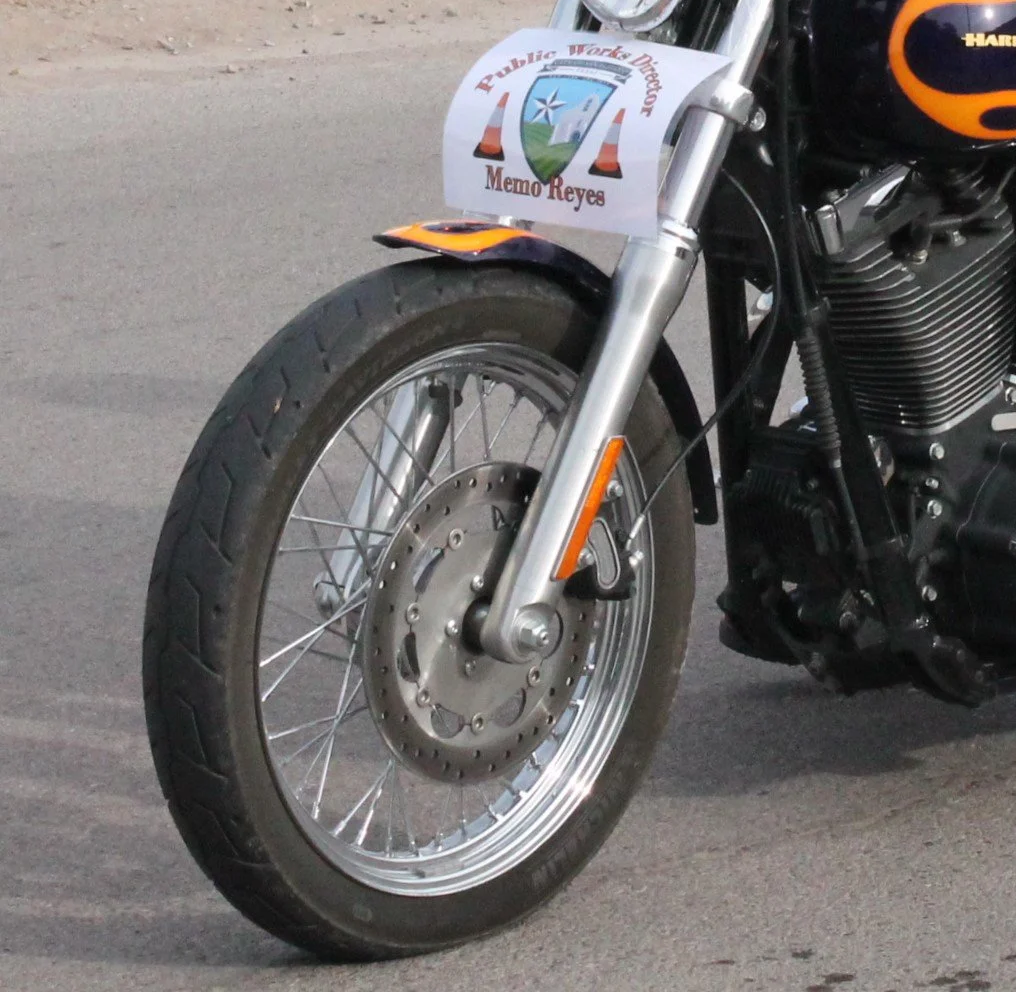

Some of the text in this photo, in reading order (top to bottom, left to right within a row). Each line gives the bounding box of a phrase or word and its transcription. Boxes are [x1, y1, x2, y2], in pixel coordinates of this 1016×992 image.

[475, 43, 664, 118] Public Works Director
[485, 164, 606, 212] Memo Reyes
